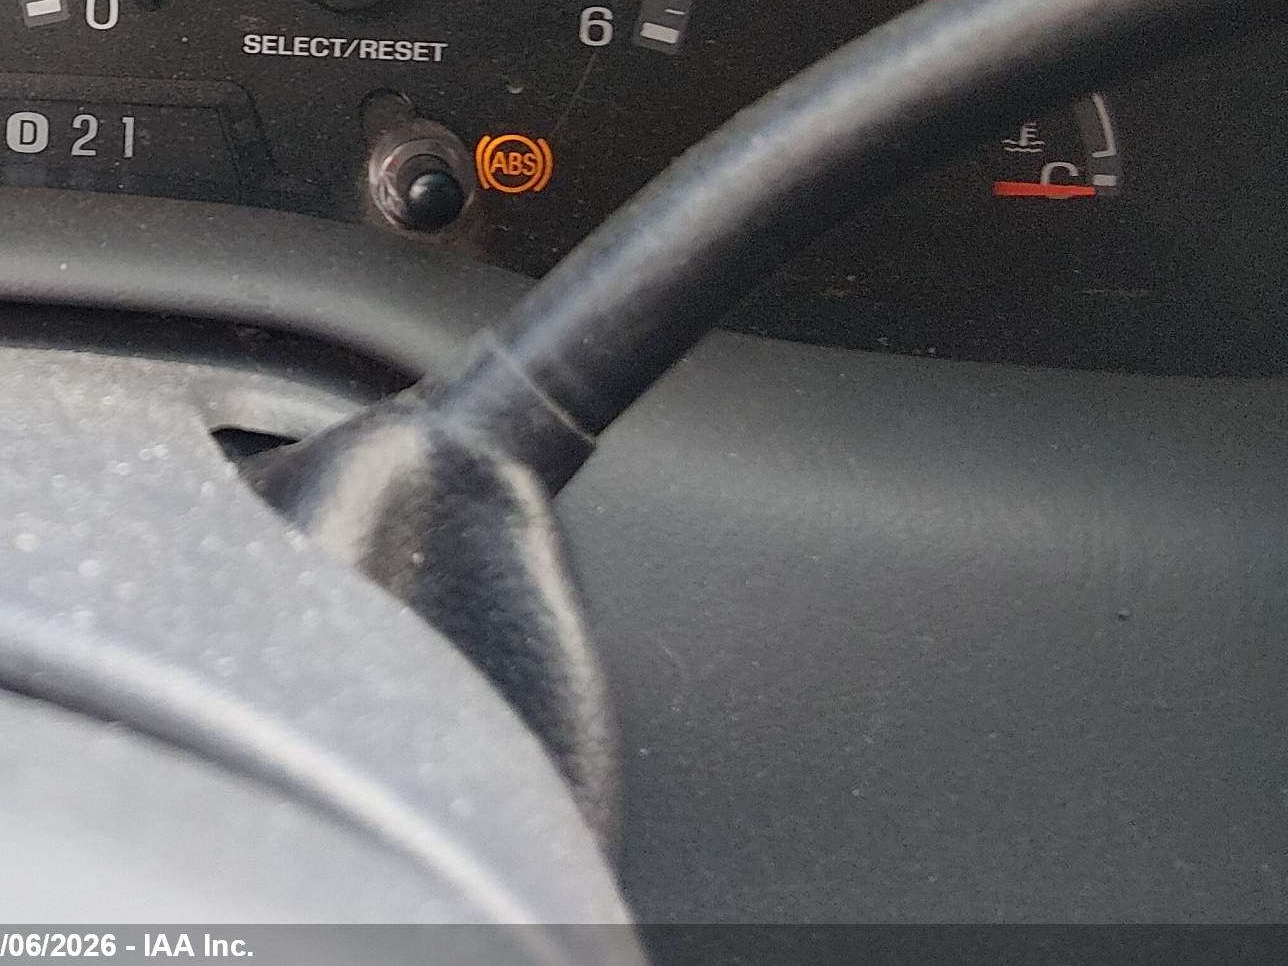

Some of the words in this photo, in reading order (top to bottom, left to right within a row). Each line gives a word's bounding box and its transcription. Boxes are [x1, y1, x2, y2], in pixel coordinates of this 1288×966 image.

[580, 7, 612, 46] 6
[243, 35, 447, 61] SELECT/RESET
[71, 115, 97, 155] 2
[123, 117, 134, 157] 1
[491, 151, 537, 176] ABS
